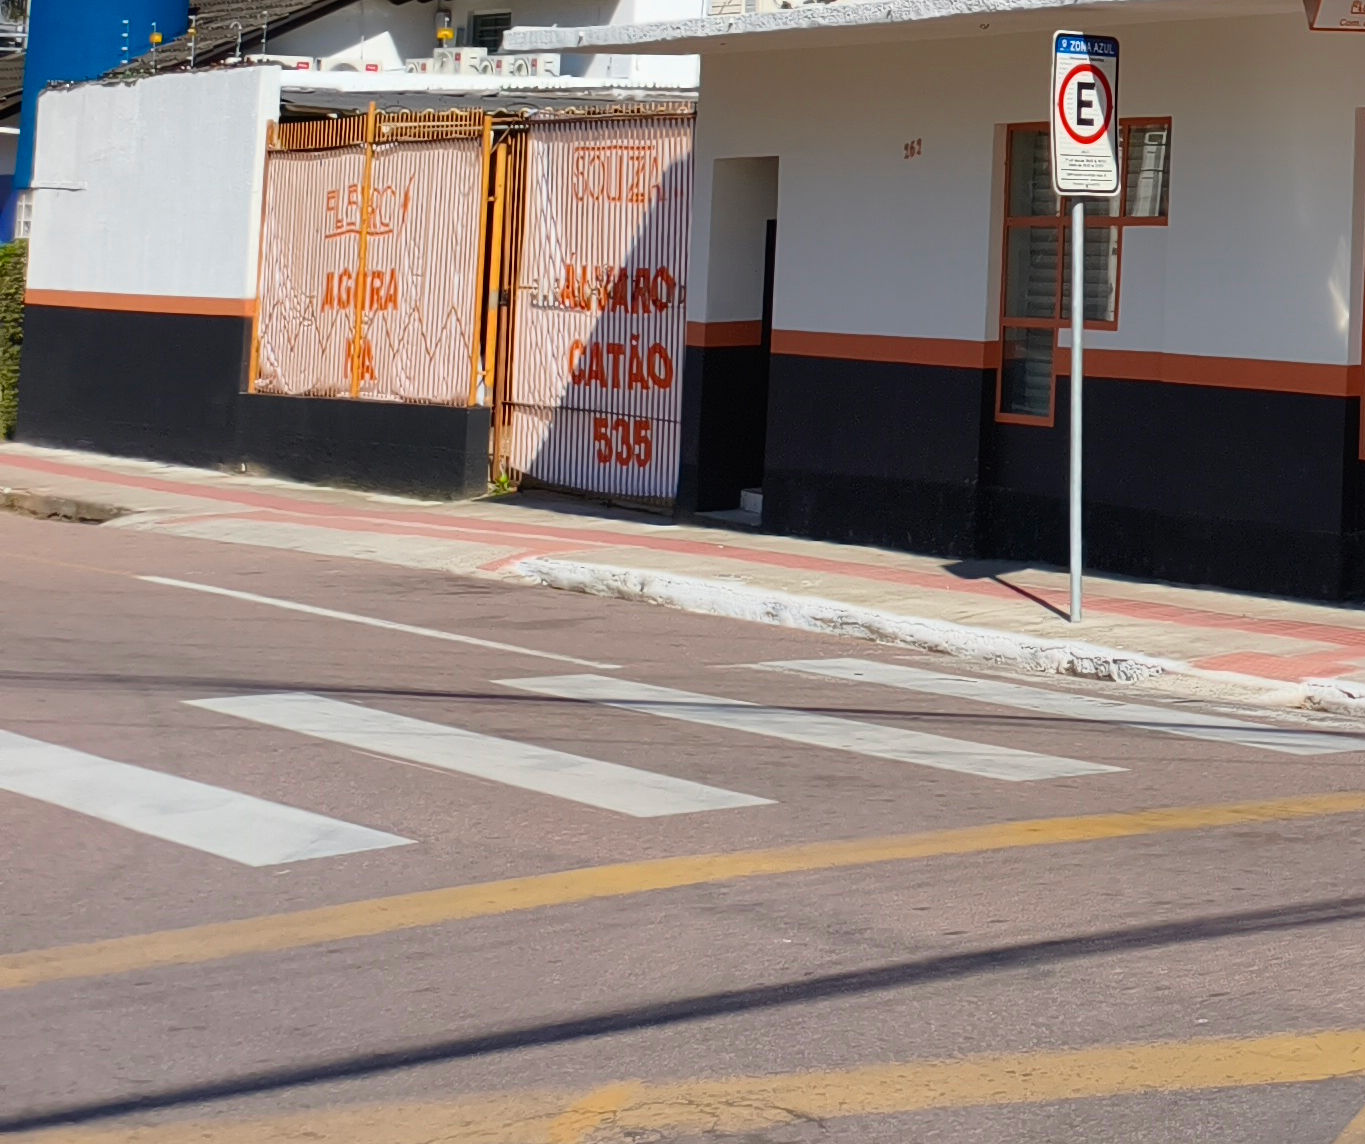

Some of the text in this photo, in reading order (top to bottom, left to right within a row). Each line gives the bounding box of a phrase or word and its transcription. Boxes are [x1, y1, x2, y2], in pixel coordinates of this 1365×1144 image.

[1069, 40, 1115, 55] ZONA AZUL
[1077, 81, 1096, 127] E
[325, 184, 397, 238] ELERO
[568, 333, 674, 391] CATÃO
[593, 416, 653, 468] 535
